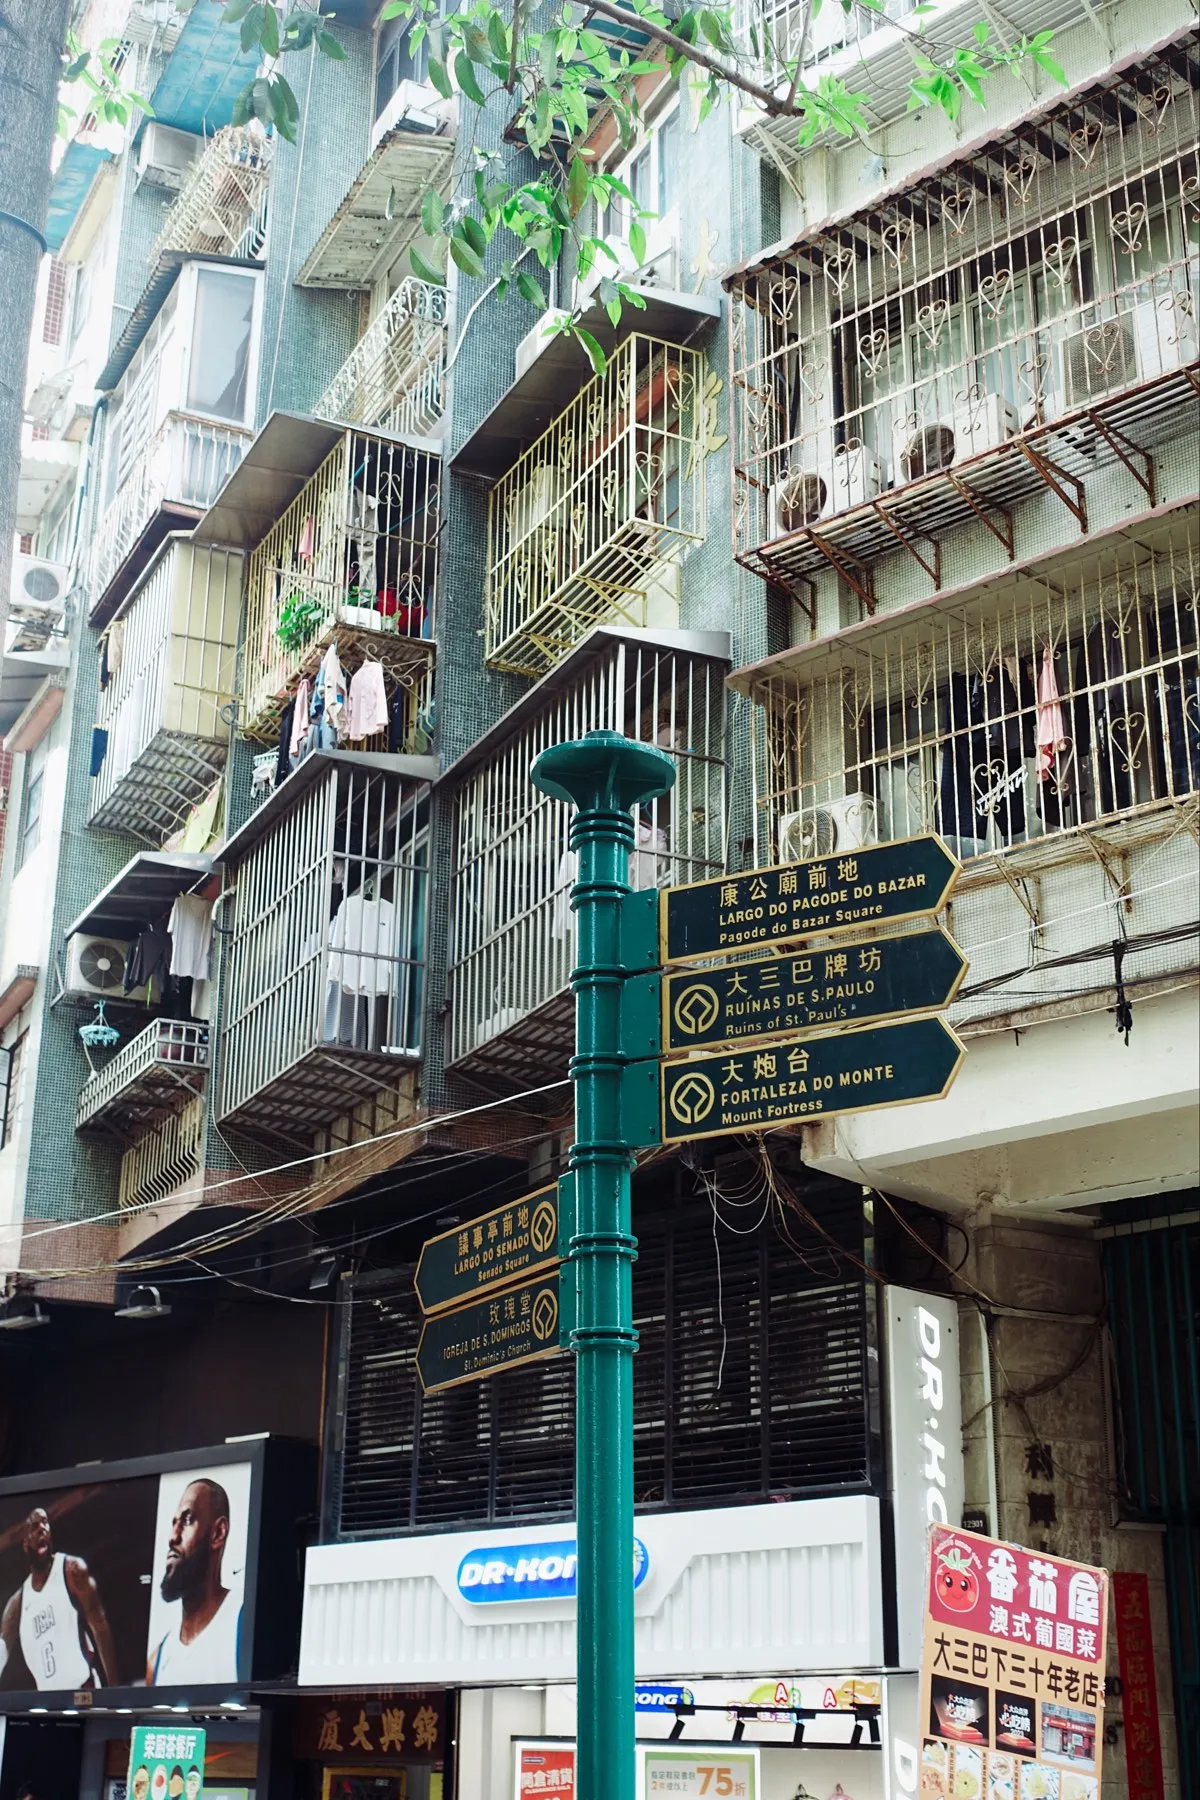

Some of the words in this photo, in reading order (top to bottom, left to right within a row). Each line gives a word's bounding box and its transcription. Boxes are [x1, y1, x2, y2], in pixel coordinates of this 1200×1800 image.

[719, 907, 764, 926] LARGO
[769, 902, 788, 917] DO
[792, 889, 848, 912] PAGODE
[853, 885, 872, 898] DO
[878, 873, 926, 894] BAZAR
[720, 858, 859, 907] 康公廟前地
[719, 925, 767, 945] Pagode
[771, 921, 787, 934] do
[792, 914, 830, 930] Bazar
[835, 902, 883, 923] Square
[726, 947, 882, 997] 大三巴牌坊
[725, 995, 781, 1017] RUÍNAS
[786, 992, 805, 1007] DE
[726, 1019, 762, 1036] Ruins
[767, 1015, 780, 1029] of
[785, 1011, 803, 1026] St.
[808, 1004, 847, 1022] Paul's
[721, 1048, 810, 1086] 大炮台
[721, 1081, 807, 1106] FORTALEZA
[813, 1074, 834, 1091] DO
[839, 1064, 894, 1086] MONTE
[721, 1107, 763, 1125] Mount
[767, 1099, 823, 1119] Fortress
[458, 1204, 529, 1256] 議事亭前地
[454, 1257, 480, 1275] LARGO
[482, 1249, 494, 1264] DO
[496, 1232, 530, 1258] SENADO
[477, 1262, 503, 1282] Senado
[505, 1253, 530, 1272] Square
[489, 1290, 531, 1325] 玫瑰堂
[443, 1340, 469, 1360] IGREJA
[471, 1336, 481, 1350] DE
[483, 1333, 490, 1346] S.
[491, 1318, 531, 1343] DOMINGOS
[507, 1339, 531, 1358] Church
[985, 1547, 1100, 1626] 番茄屋
[988, 1603, 1097, 1660] 澳式葡國菜
[933, 1631, 1099, 1708] 大三巴下三十年老店
